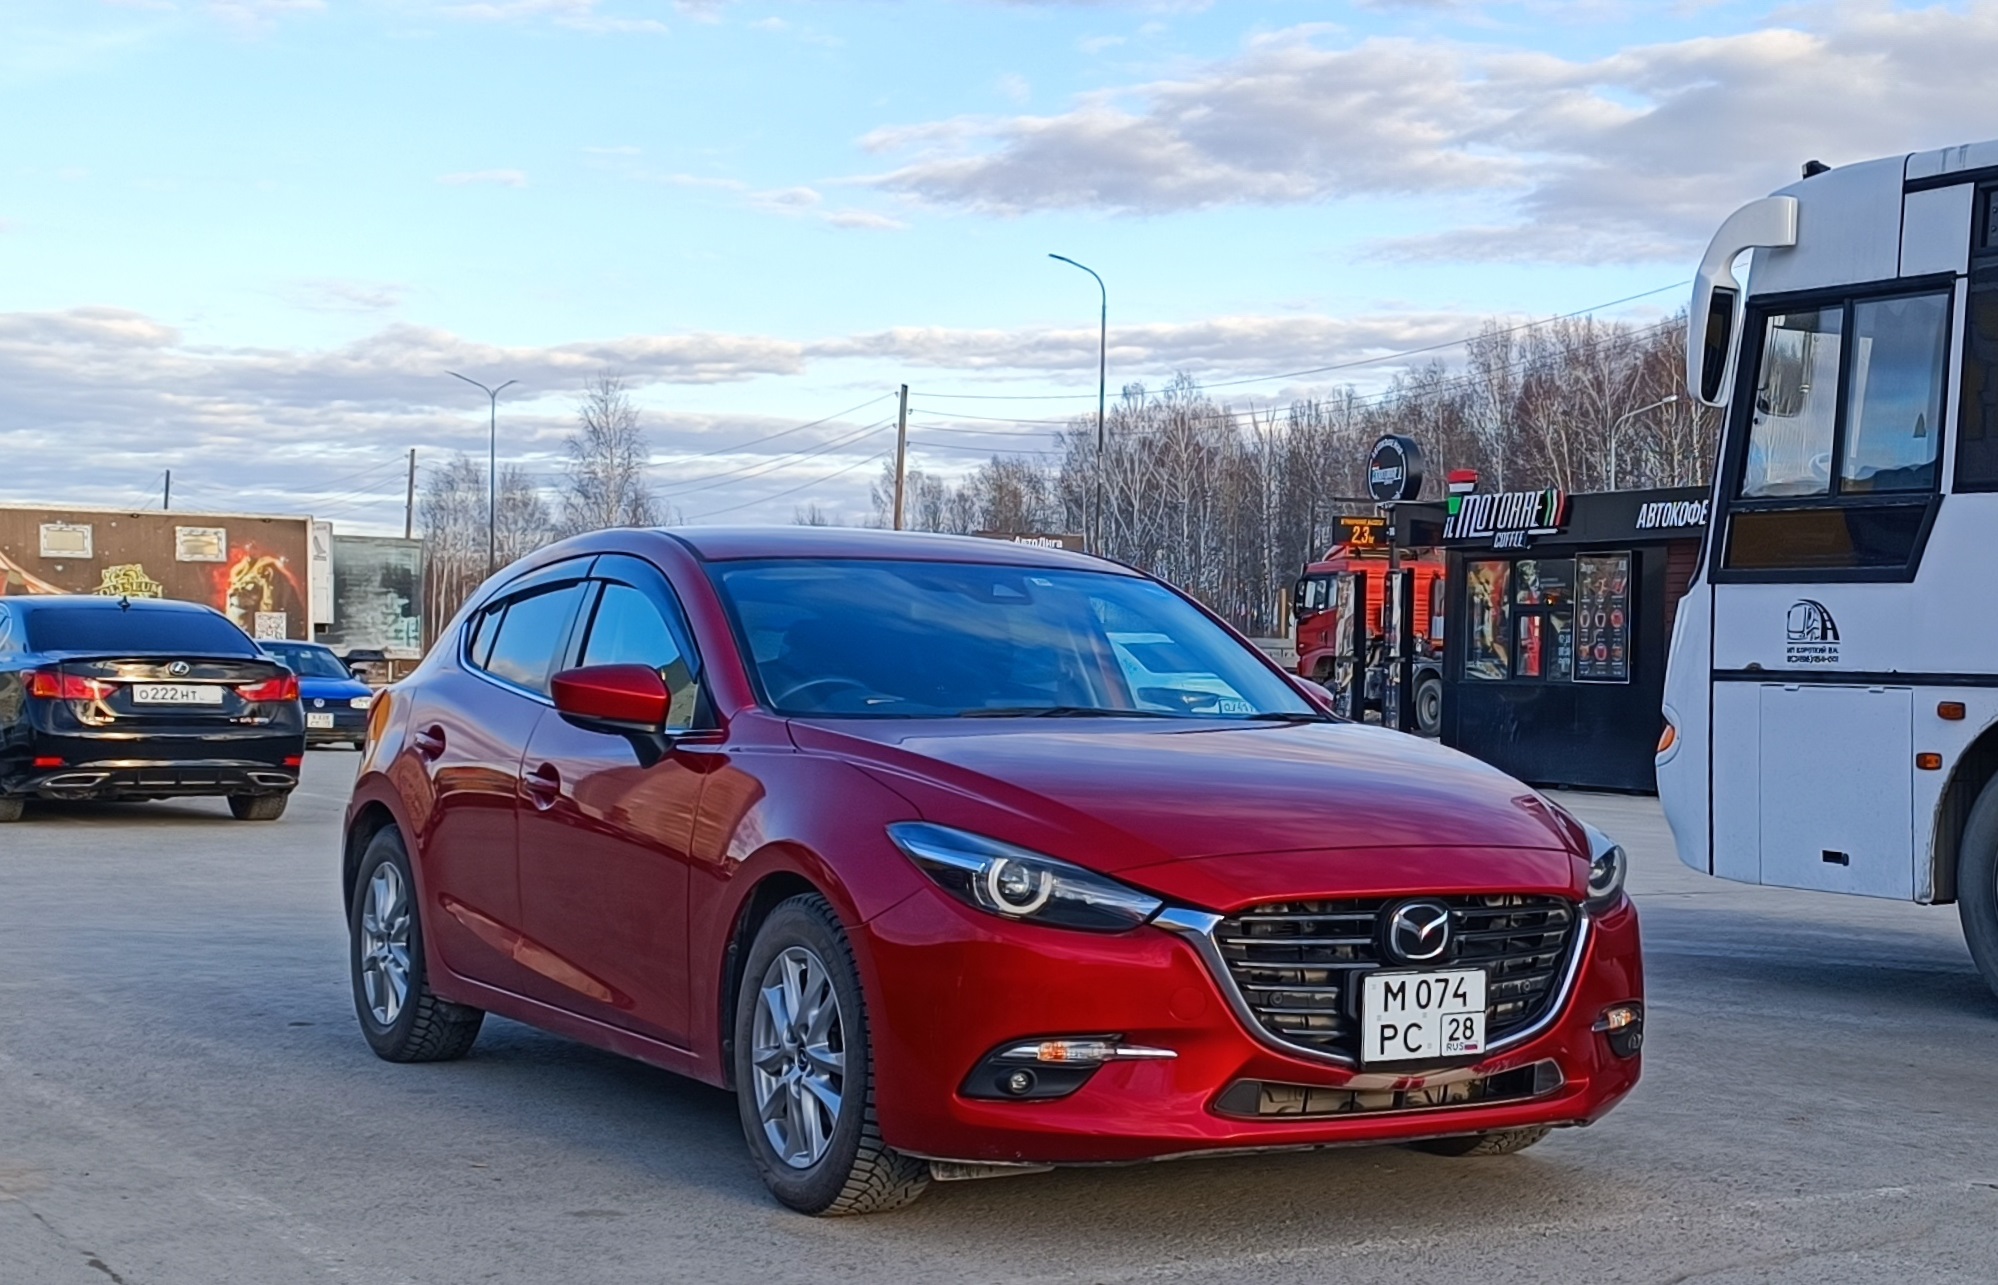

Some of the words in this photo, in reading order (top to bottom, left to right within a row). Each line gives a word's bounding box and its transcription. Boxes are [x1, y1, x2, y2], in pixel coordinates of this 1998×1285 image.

[1494, 530, 1525, 548] COFFEE
[1416, 977, 1468, 1010] 074
[1448, 1017, 1475, 1042] 28
[1446, 1042, 1464, 1051] RUS
